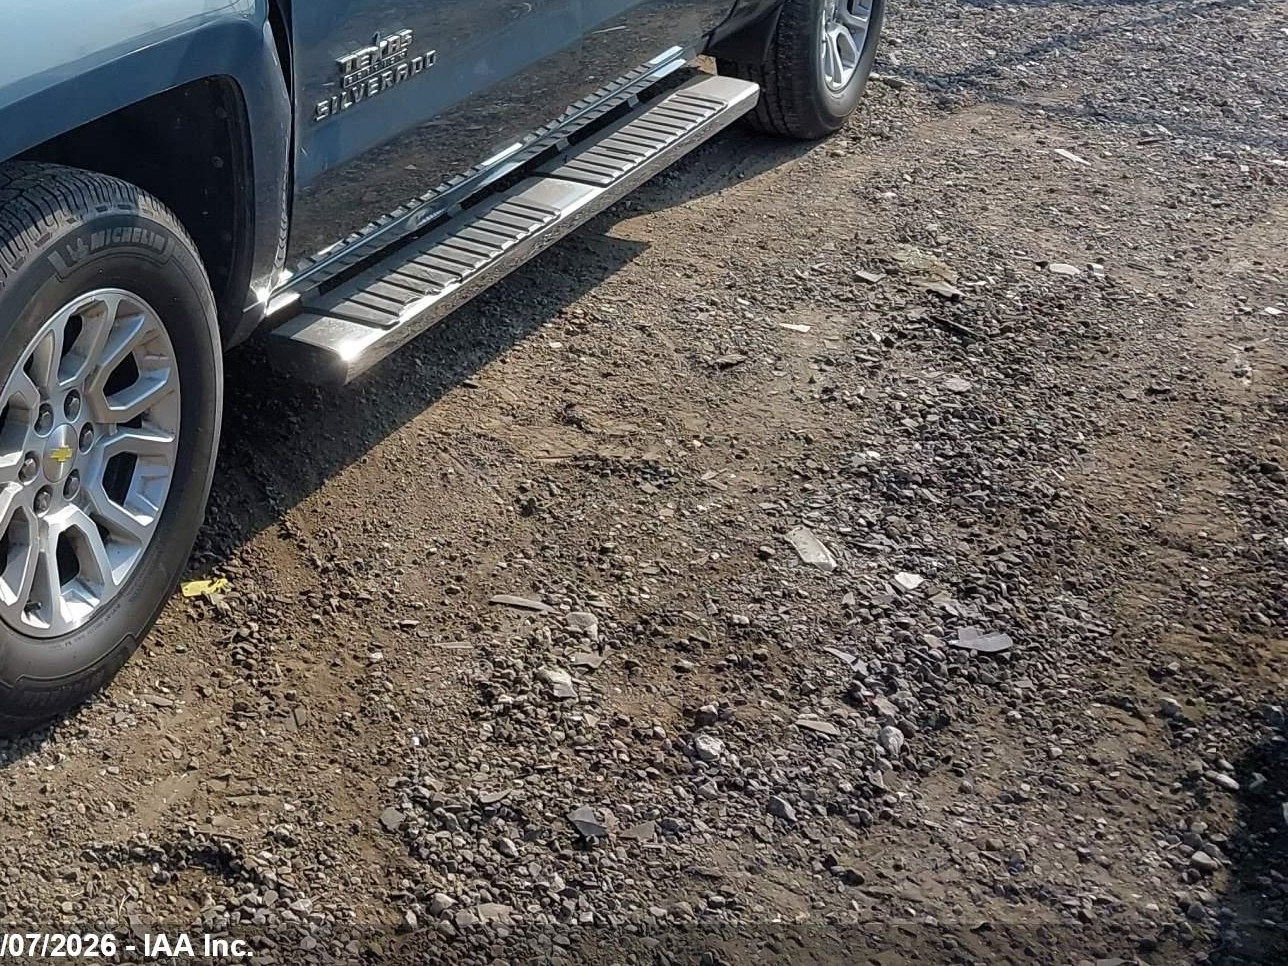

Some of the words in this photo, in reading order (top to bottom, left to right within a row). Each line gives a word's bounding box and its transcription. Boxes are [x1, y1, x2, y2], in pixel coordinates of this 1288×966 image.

[336, 28, 414, 73] TEXAS
[315, 49, 437, 122] SILVERADO
[89, 226, 166, 252] MICHELIN
